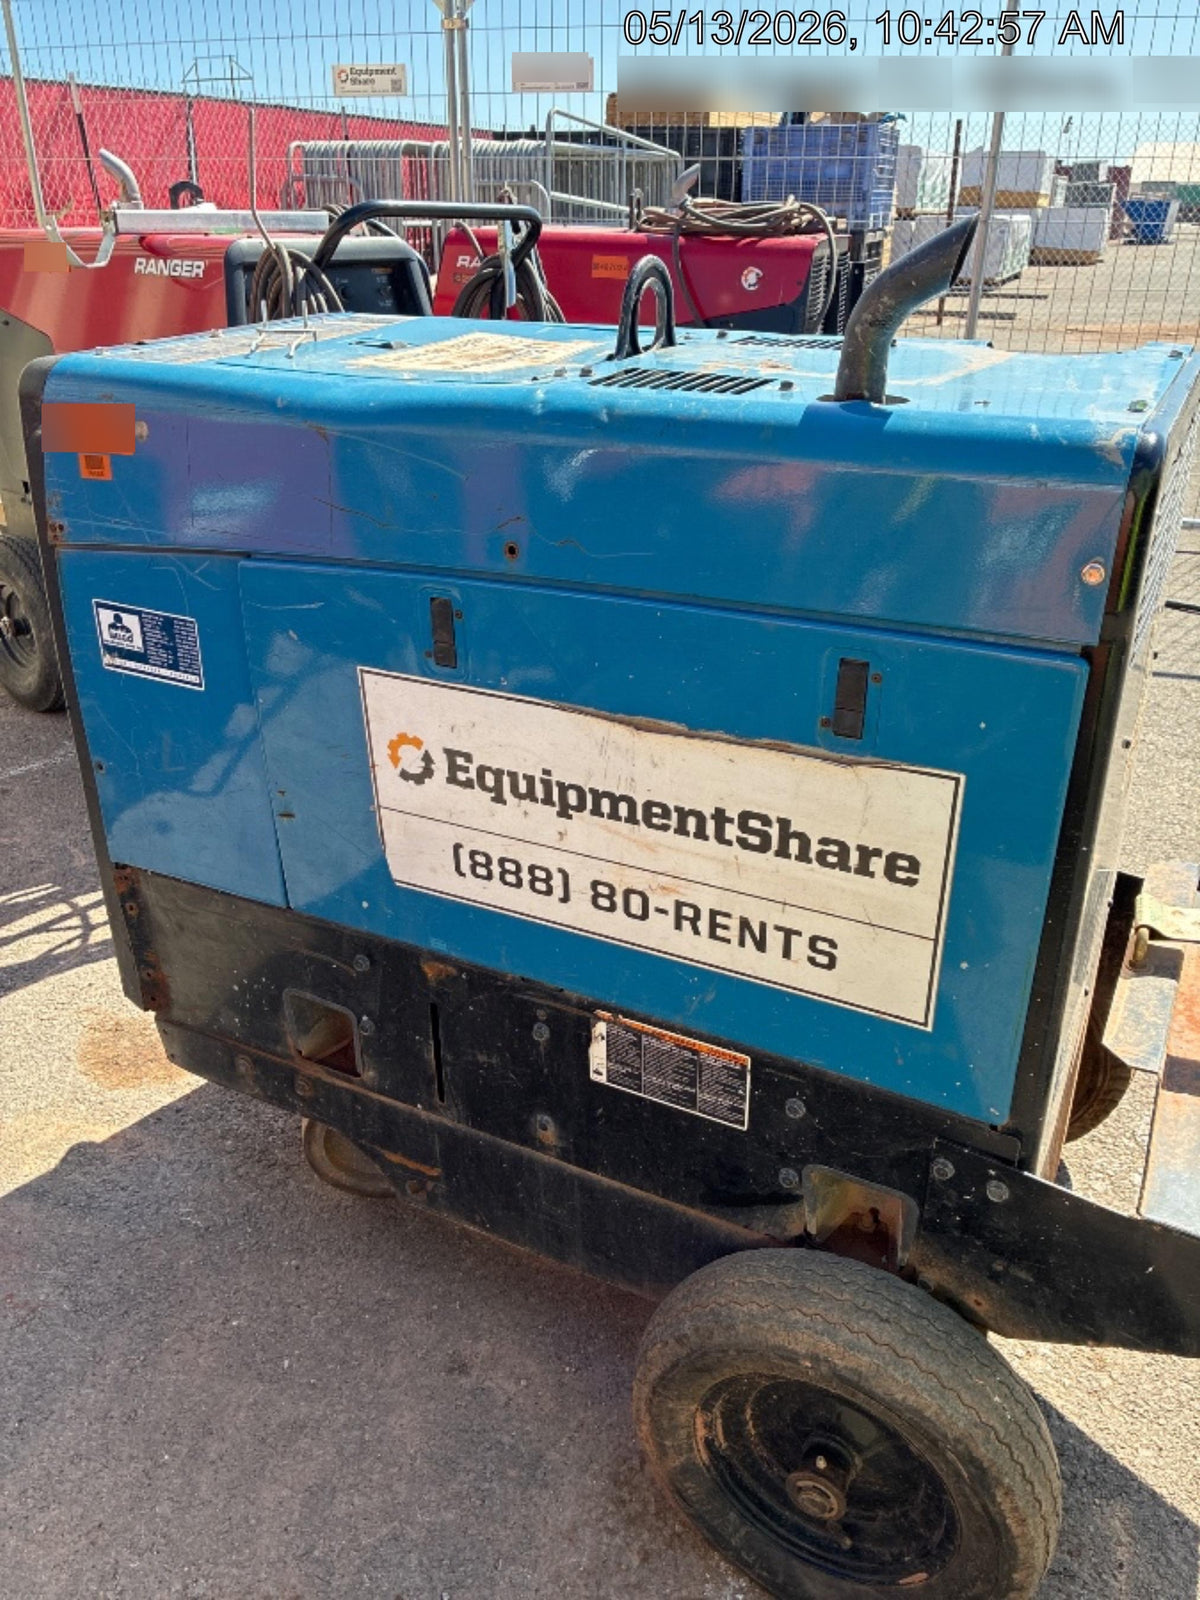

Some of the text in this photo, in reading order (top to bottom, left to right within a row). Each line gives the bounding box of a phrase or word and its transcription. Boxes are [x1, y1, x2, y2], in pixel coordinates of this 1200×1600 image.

[349, 66, 397, 77] Equipment
[134, 257, 205, 278] RANGER
[442, 746, 922, 888] EquipmentShare
[452, 841, 839, 972] (888) 80-RENTS
